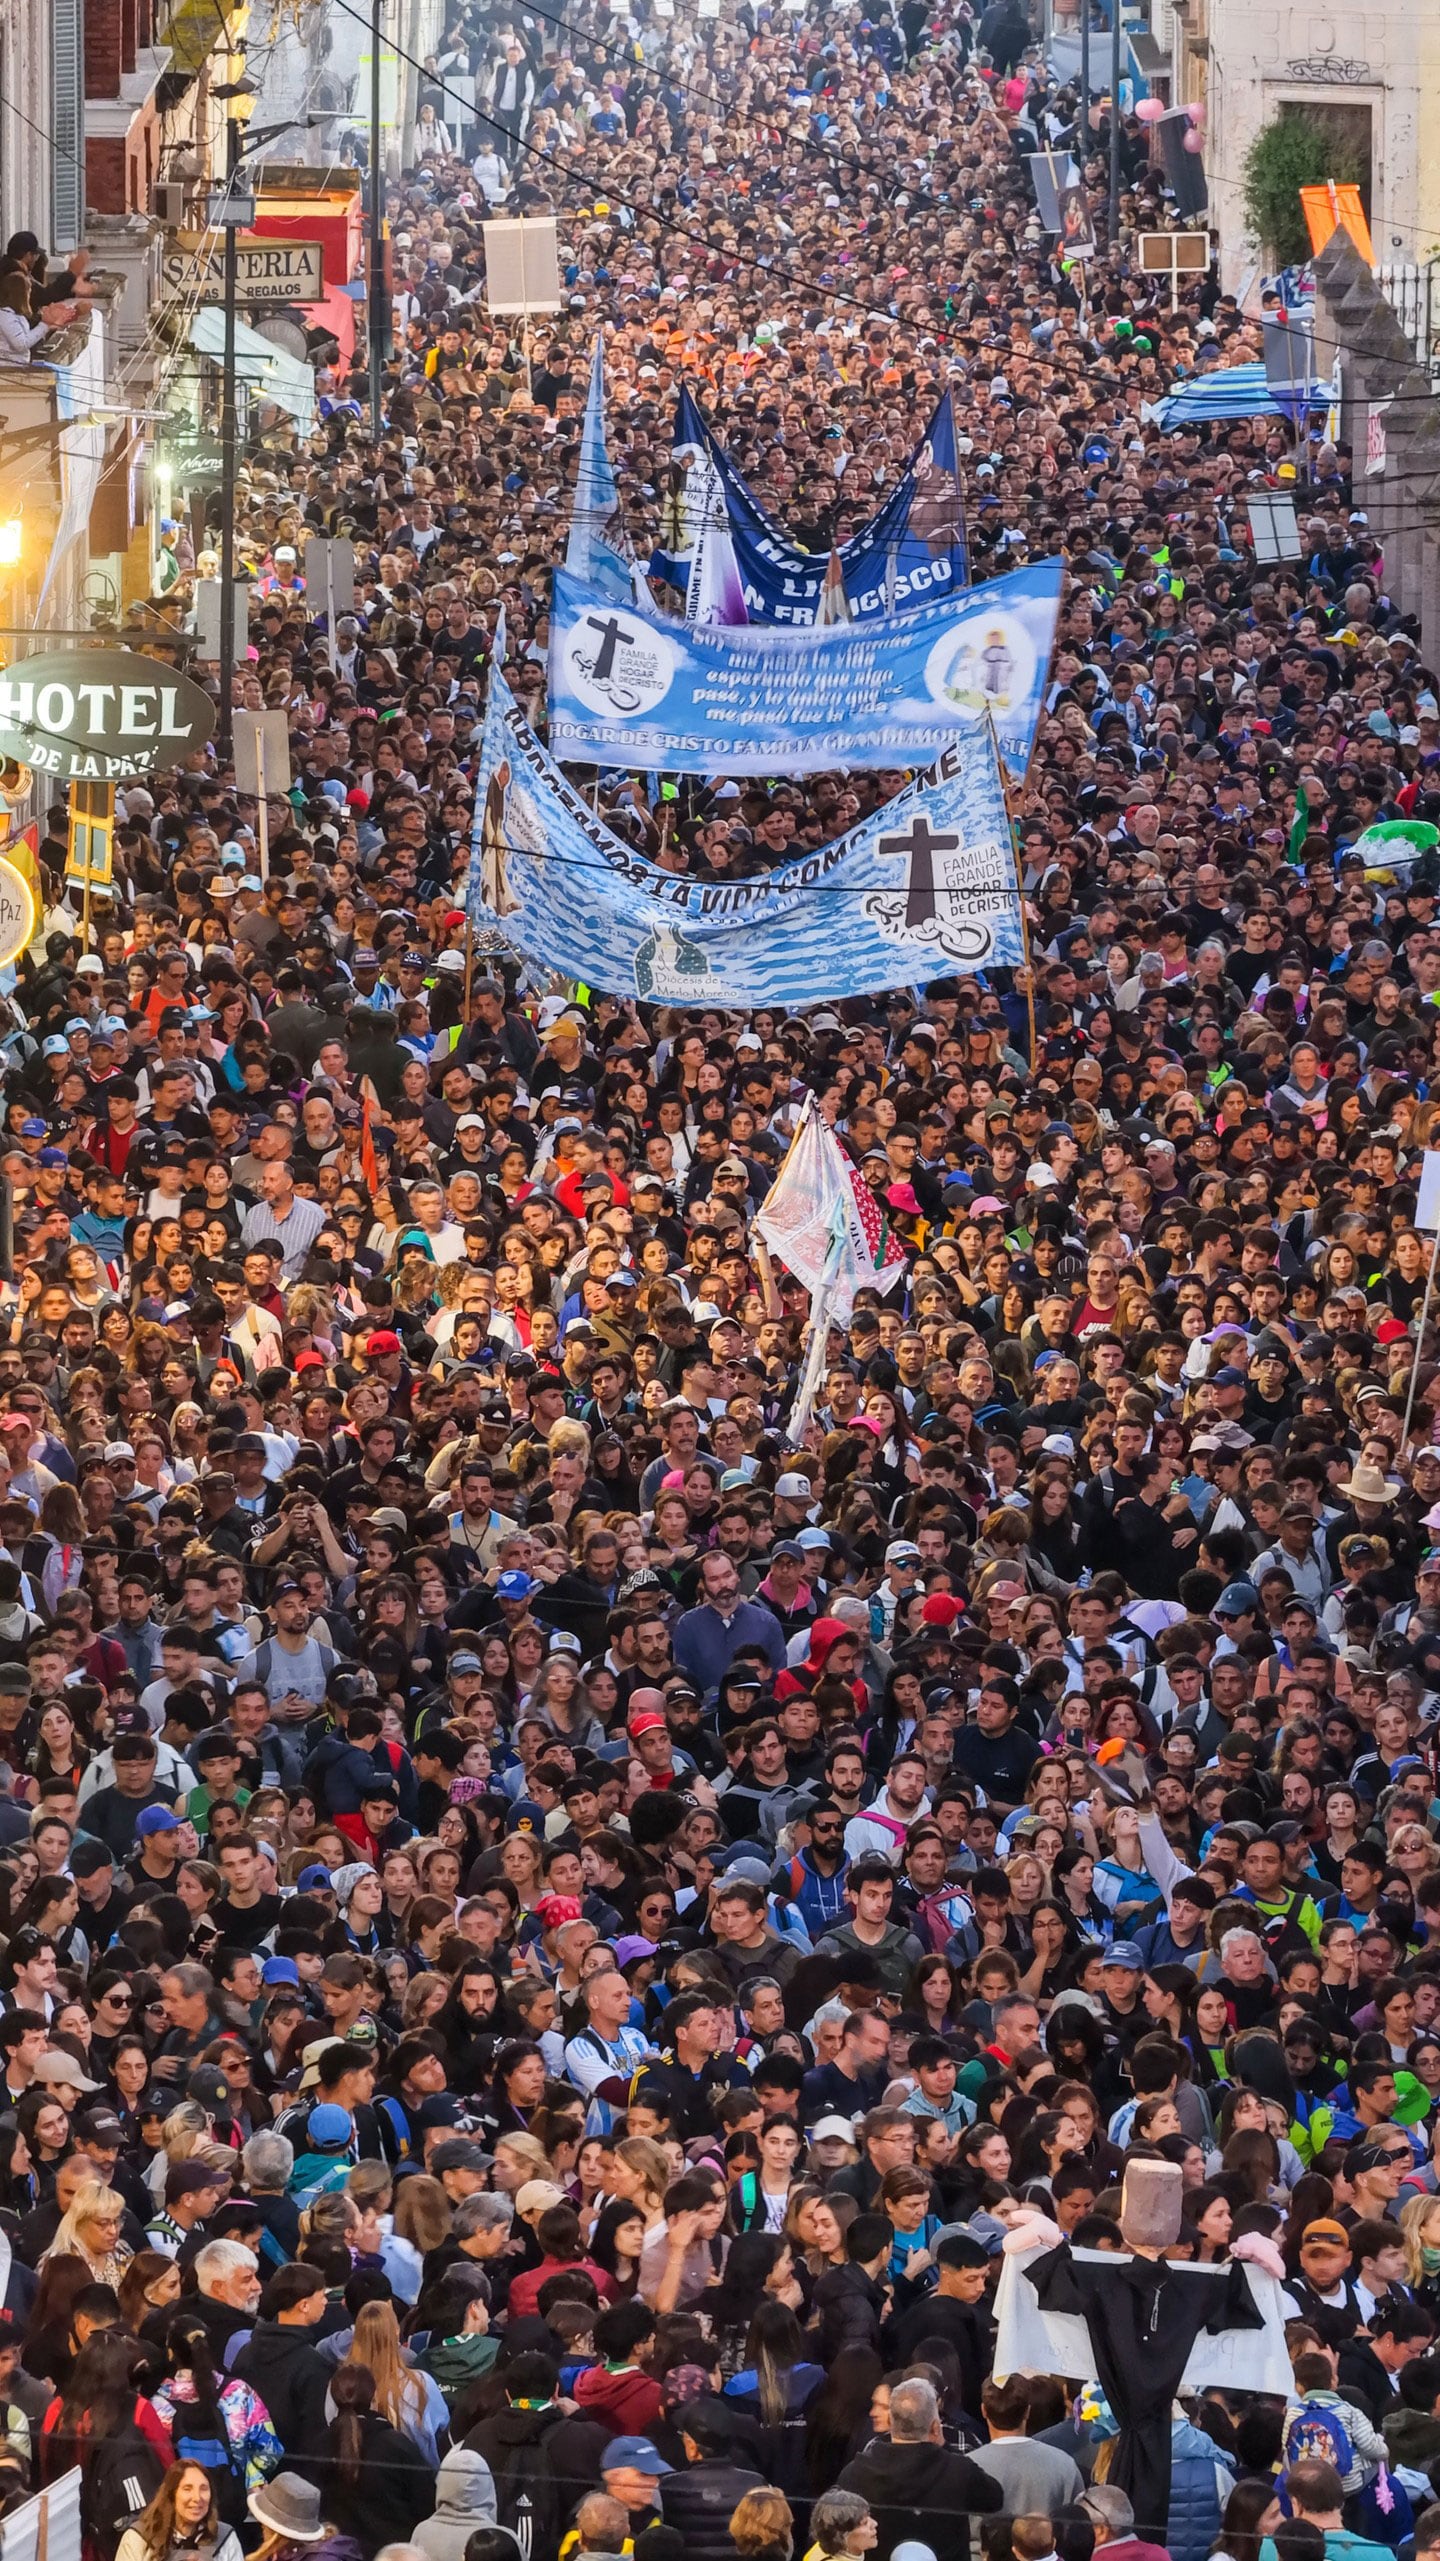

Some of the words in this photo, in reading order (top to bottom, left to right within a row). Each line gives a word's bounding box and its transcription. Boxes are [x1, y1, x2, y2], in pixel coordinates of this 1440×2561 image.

[168, 250, 314, 283] SANTERIA
[246, 284, 301, 298] REGALOS
[687, 577, 702, 621] GUIAME
[619, 658, 660, 671] GRANDE
[620, 649, 658, 661] FAMILIA
[619, 667, 655, 679] HOGAR
[705, 671, 811, 688] esperando
[0, 682, 194, 738] HOTEL
[748, 691, 763, 709] y
[548, 722, 616, 744] HOGAR
[619, 729, 649, 747] DE
[650, 731, 731, 754] CRISTO
[29, 743, 62, 772] DE
[69, 754, 101, 777] LA
[104, 749, 156, 777] PAZ
[702, 881, 772, 914] VIDA
[777, 828, 868, 895] COMO
[943, 846, 999, 873] FAMILIA
[945, 860, 1004, 889] GRANDE
[948, 879, 1003, 904] HOGAR
[950, 904, 966, 916] DE
[704, 974, 719, 985] de
